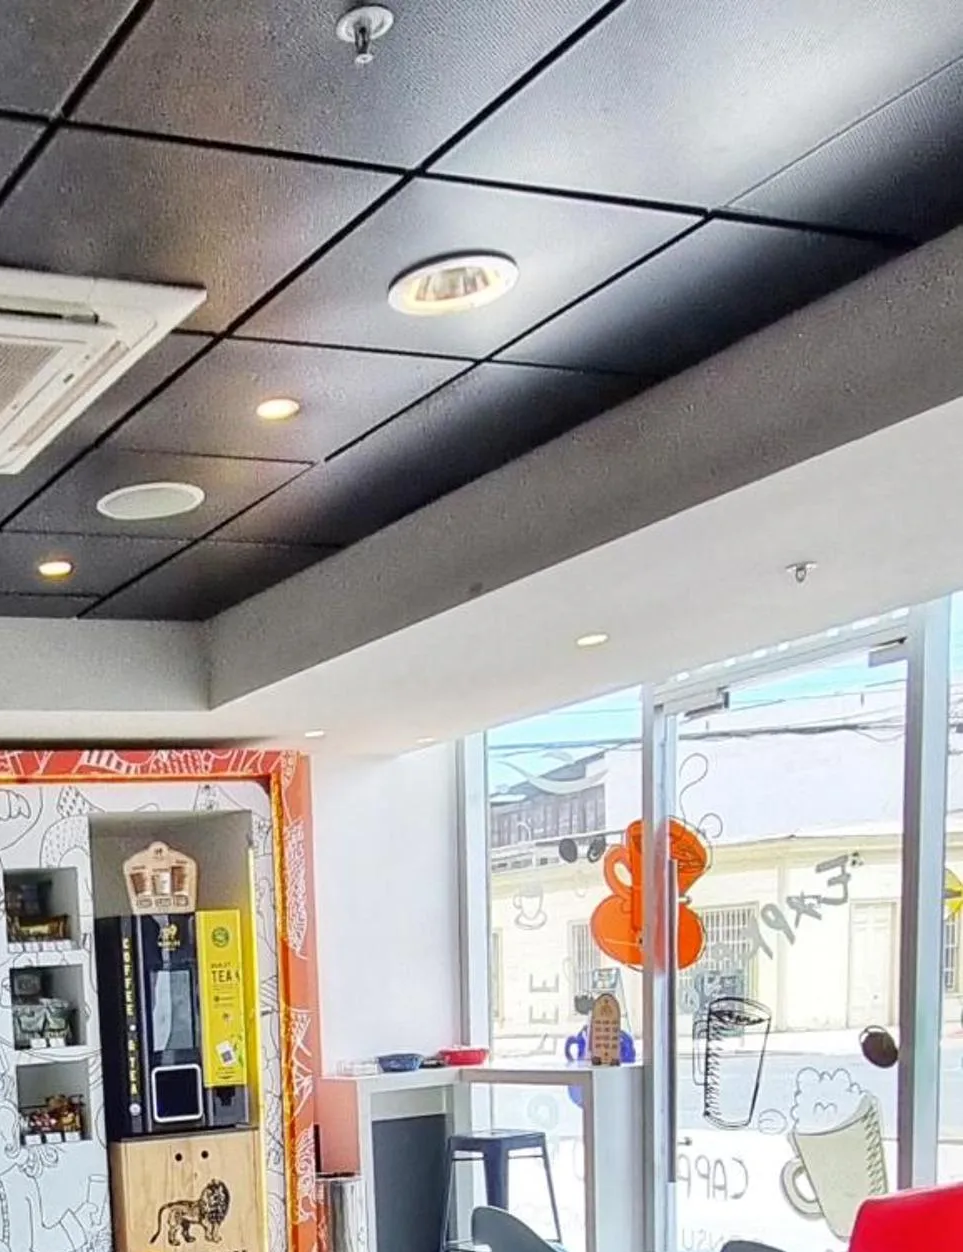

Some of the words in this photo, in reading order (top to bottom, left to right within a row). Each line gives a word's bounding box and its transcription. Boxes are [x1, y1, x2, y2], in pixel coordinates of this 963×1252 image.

[122, 938, 134, 1016] COFFEE
[129, 1057, 138, 1095] TEA
[211, 969, 233, 983] TEA
